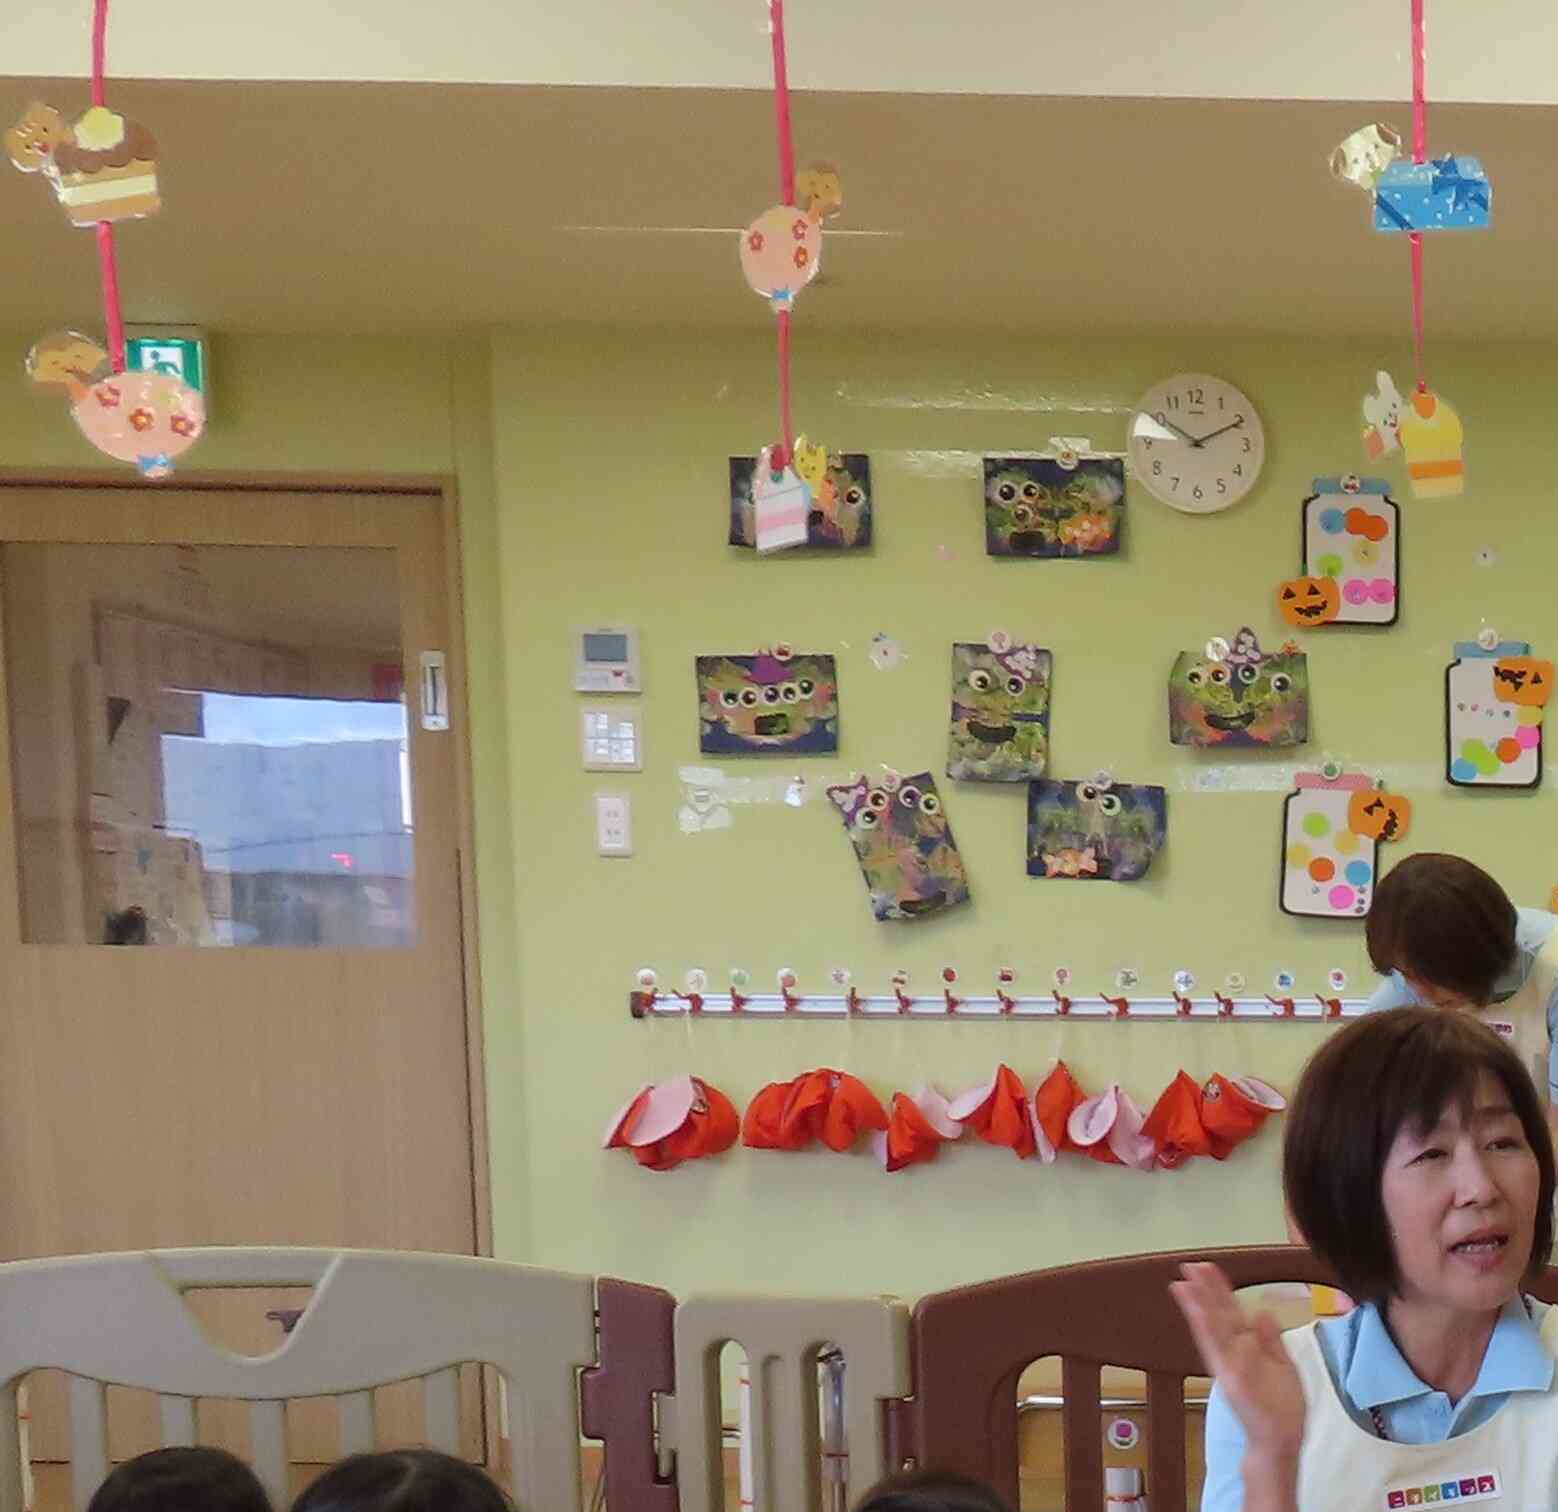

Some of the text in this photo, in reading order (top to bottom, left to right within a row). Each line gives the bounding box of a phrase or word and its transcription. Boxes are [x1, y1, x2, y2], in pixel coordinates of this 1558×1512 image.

[1166, 395, 1180, 409] 11
[1187, 388, 1204, 405] 12
[1218, 397, 1225, 410] 1
[1241, 437, 1251, 452] 3
[1152, 460, 1162, 476] 8
[1232, 463, 1242, 477] 4
[1169, 477, 1180, 492] 7
[1193, 484, 1203, 500] 6
[1216, 478, 1227, 494] 5
